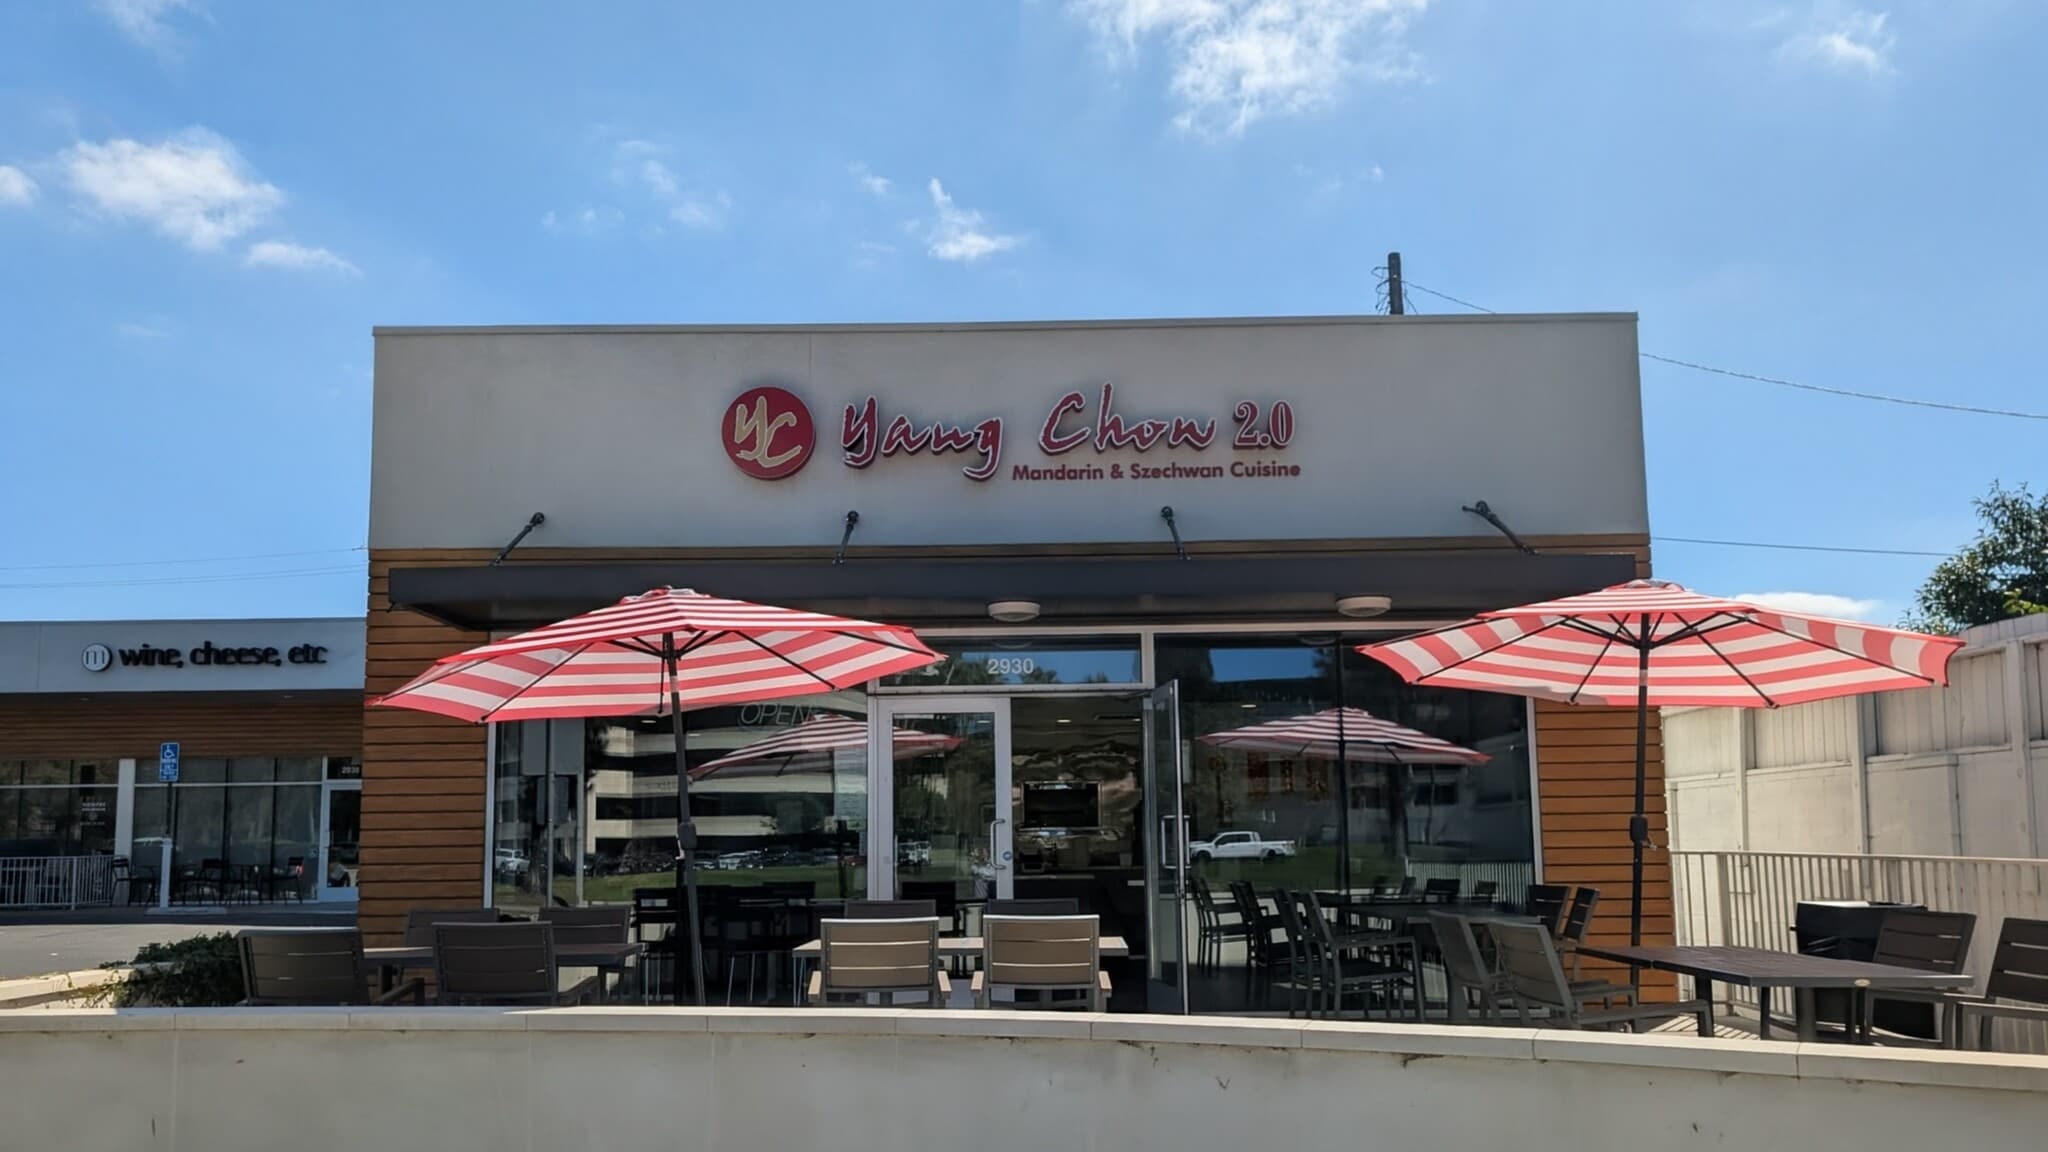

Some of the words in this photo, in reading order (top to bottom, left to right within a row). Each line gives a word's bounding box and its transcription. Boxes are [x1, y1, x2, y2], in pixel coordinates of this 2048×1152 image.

[1039, 382, 1216, 454] Chow
[1233, 400, 1295, 450] 2.0
[1012, 464, 1104, 481] Mandarin
[1110, 463, 1124, 479] &
[1130, 462, 1224, 480] Szechwan
[1230, 461, 1301, 479] Cuisine
[118, 644, 184, 668] wine,
[190, 640, 281, 667] cheese,
[287, 643, 329, 665] etc
[986, 657, 1034, 676] 2930
[740, 703, 812, 726] OPEN
